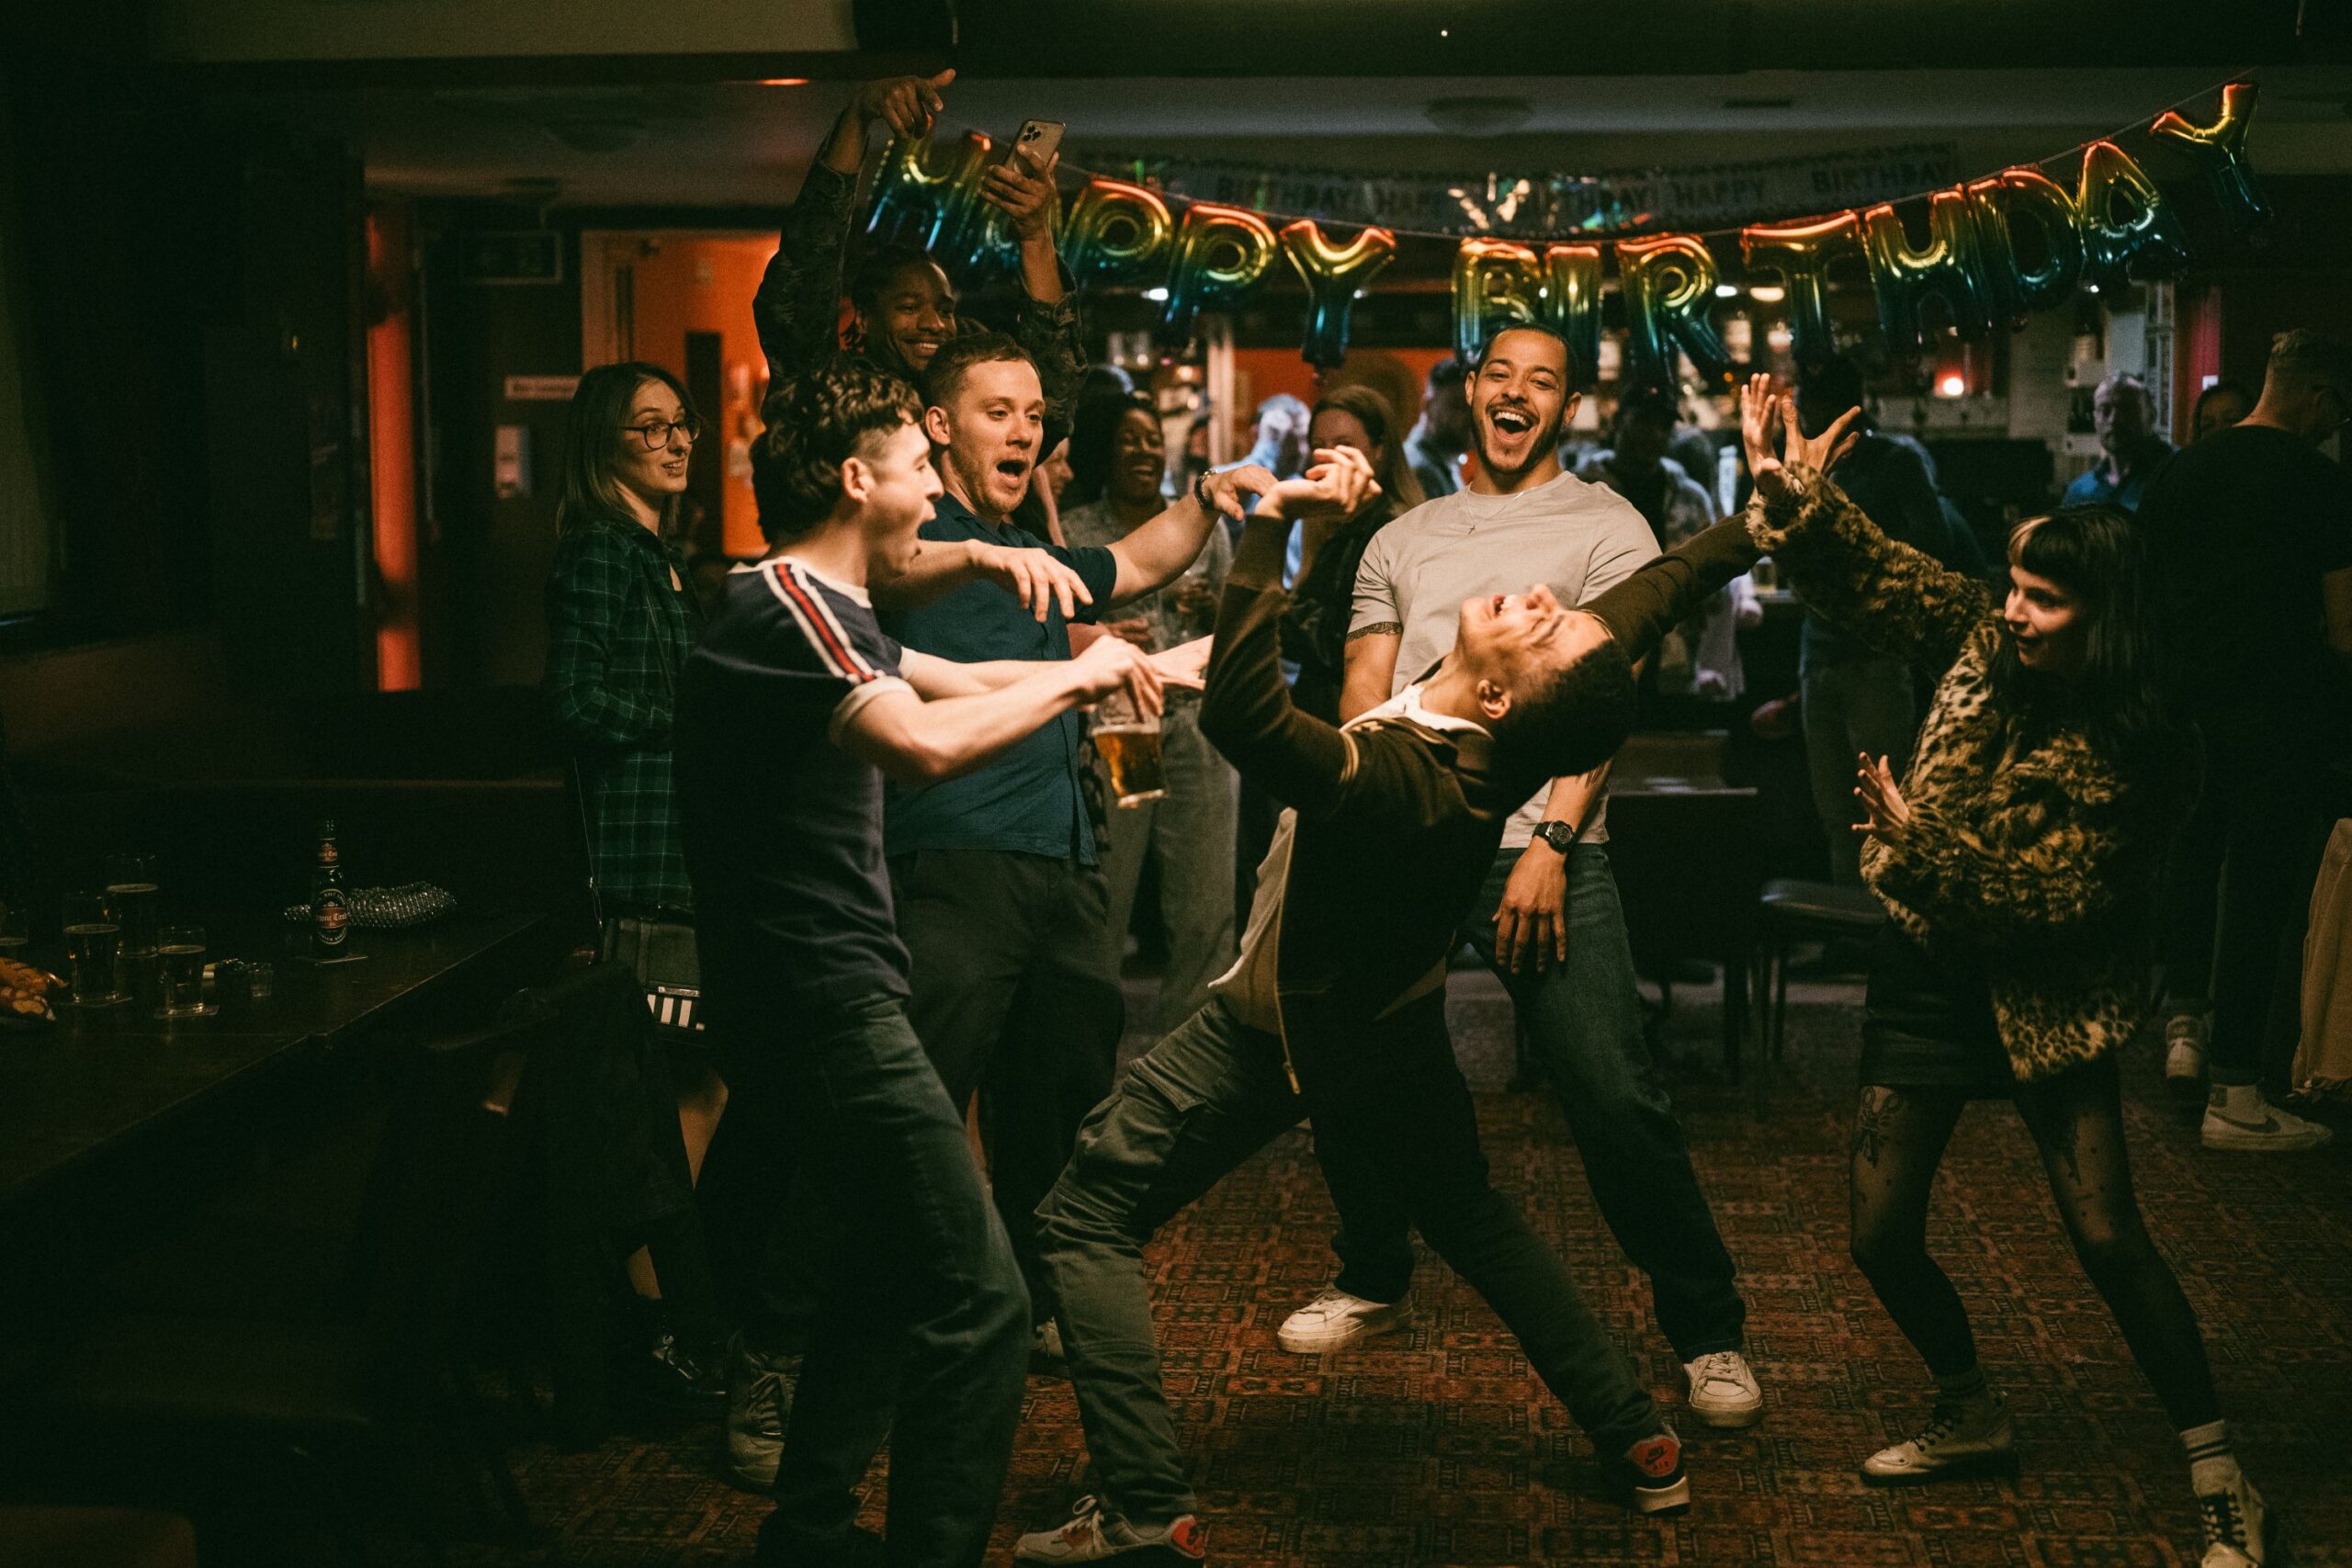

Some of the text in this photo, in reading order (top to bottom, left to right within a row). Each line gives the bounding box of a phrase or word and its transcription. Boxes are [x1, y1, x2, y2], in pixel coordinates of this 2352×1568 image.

[1453, 78, 2273, 378] BIRTHDAY
[1672, 176, 1767, 209] HAPPY
[1812, 160, 1952, 195] BIRTHDAY
